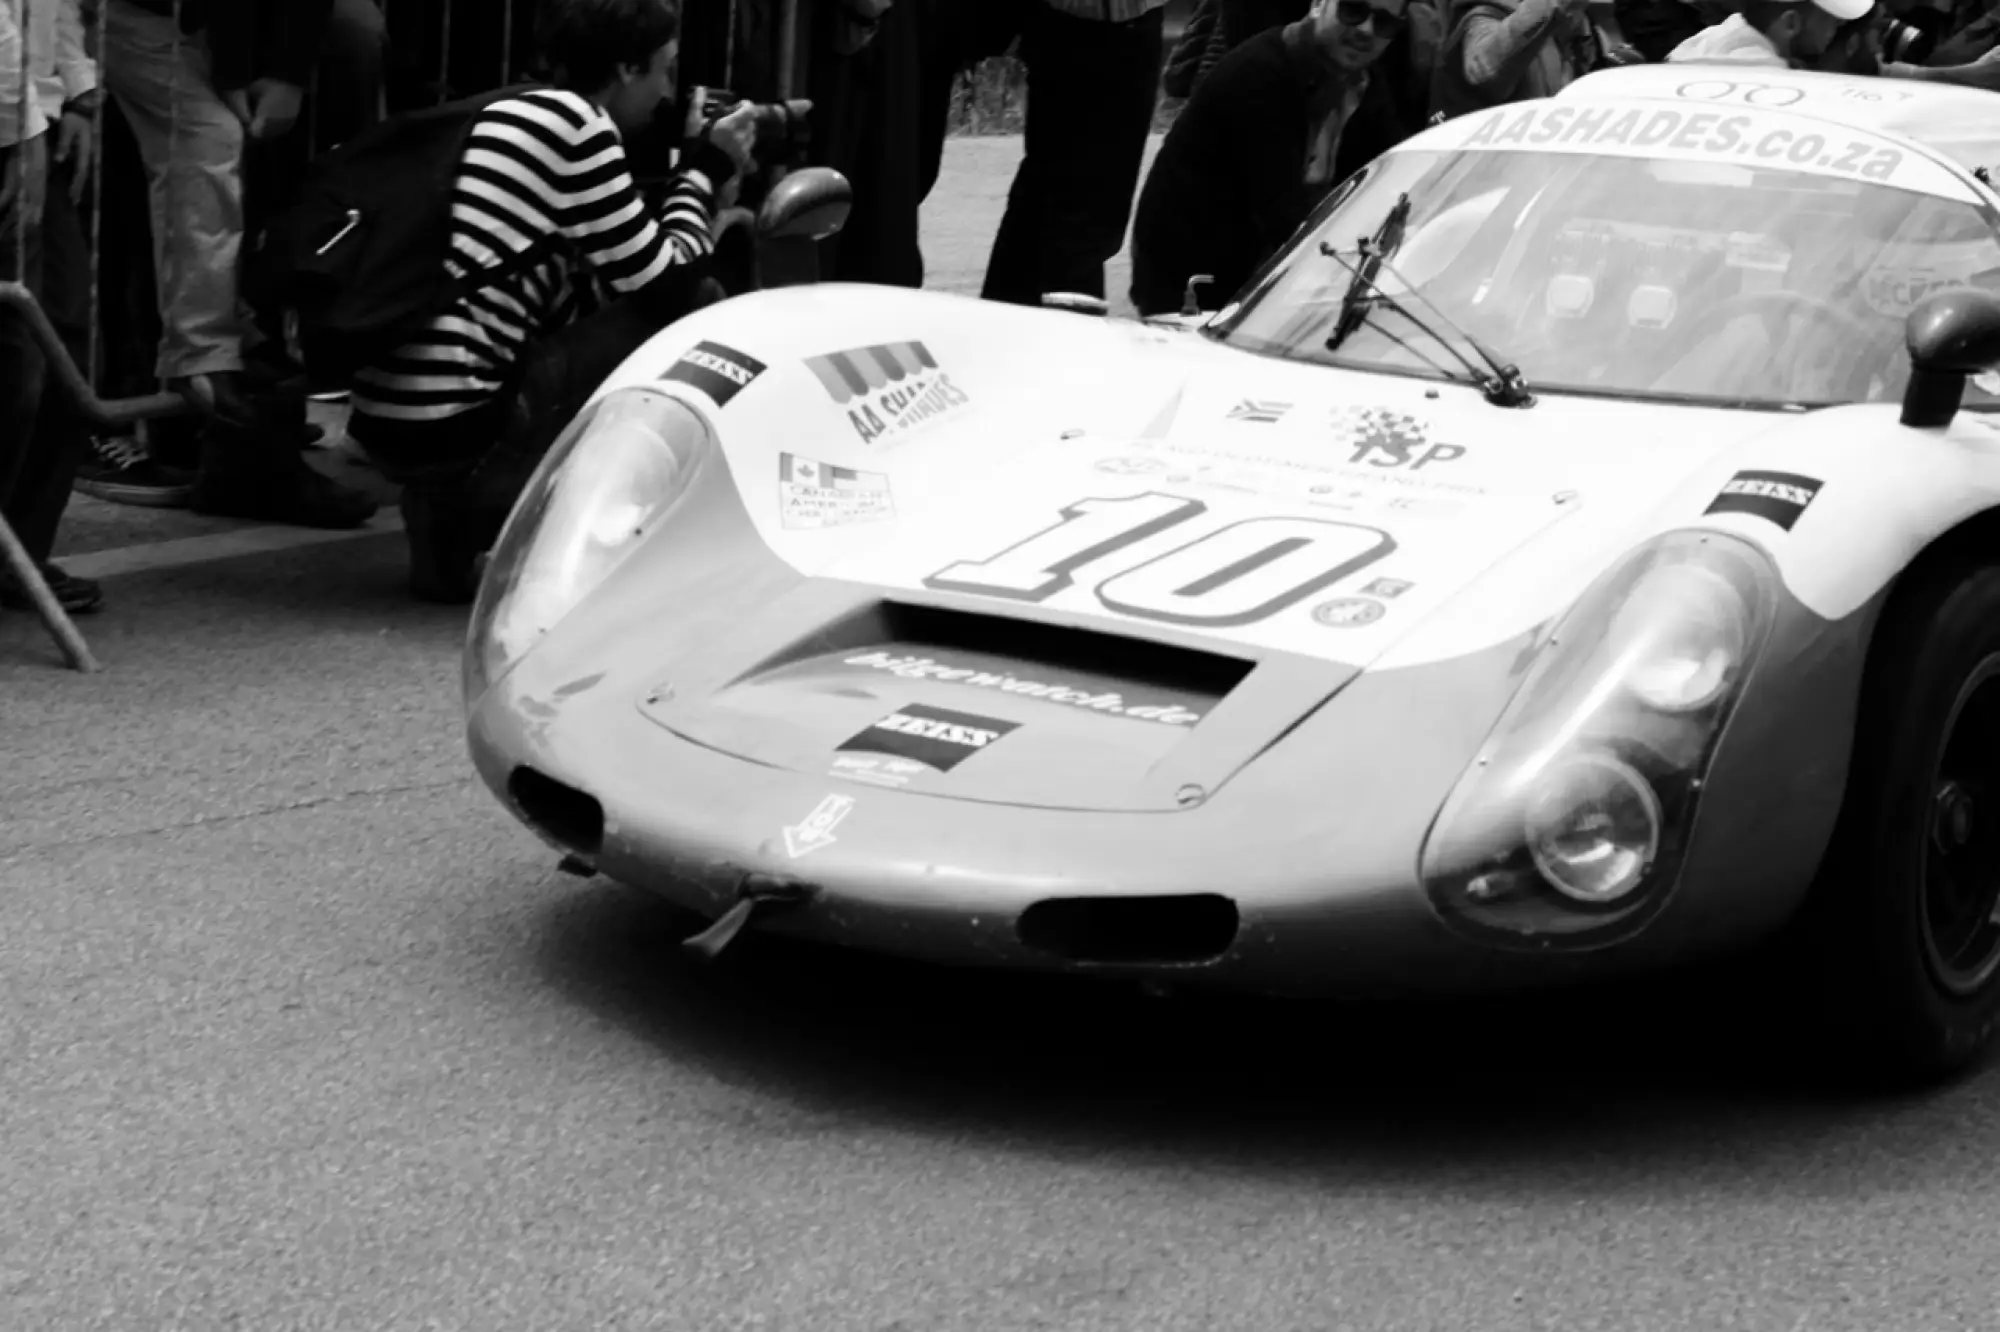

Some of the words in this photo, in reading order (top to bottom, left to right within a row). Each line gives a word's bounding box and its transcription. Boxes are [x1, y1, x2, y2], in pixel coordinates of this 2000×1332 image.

[1460, 107, 1904, 181] AASHADES.co.za
[847, 402, 894, 445] AA
[1720, 480, 1816, 505] ZEISS
[922, 491, 1398, 628] 10
[874, 713, 1000, 746] ZEISS
